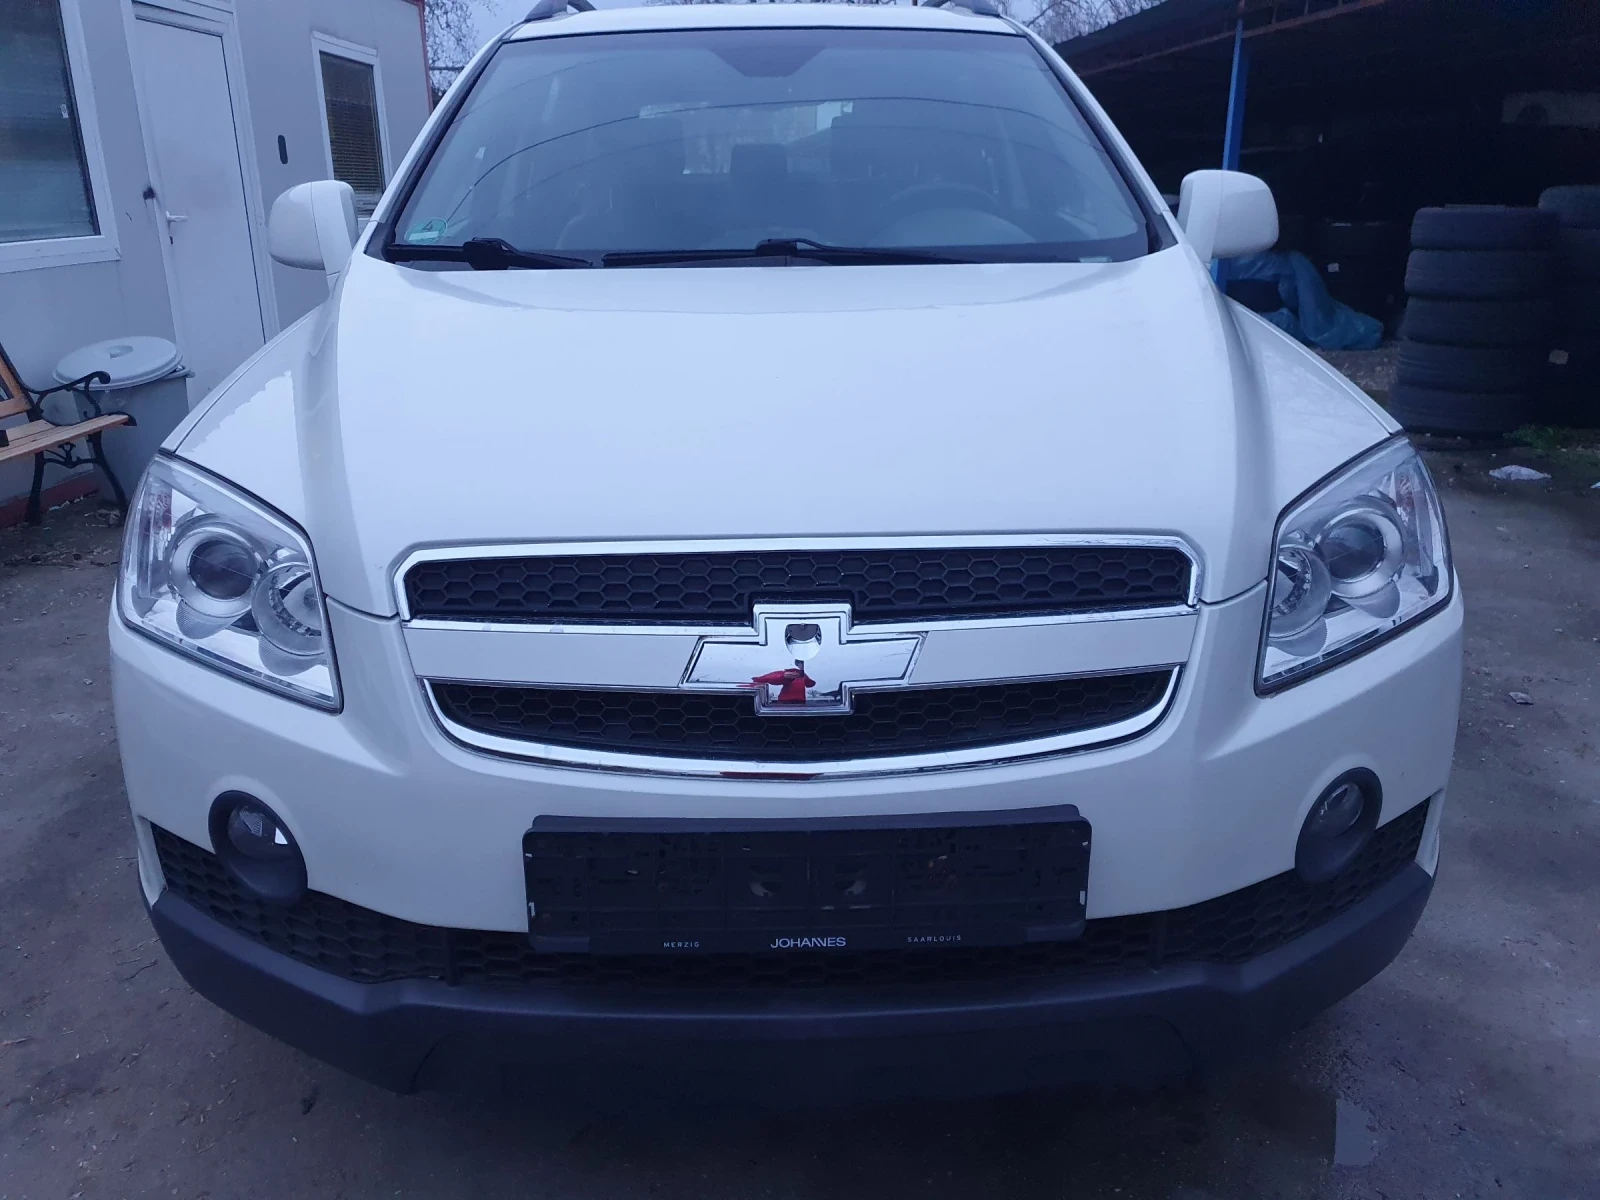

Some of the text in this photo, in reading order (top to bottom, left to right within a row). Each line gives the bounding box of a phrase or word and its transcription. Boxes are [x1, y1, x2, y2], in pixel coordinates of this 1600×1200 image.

[422, 220, 433, 232] 4
[770, 937, 847, 949] JOHANNES
[907, 934, 962, 943] SAARLOUIS
